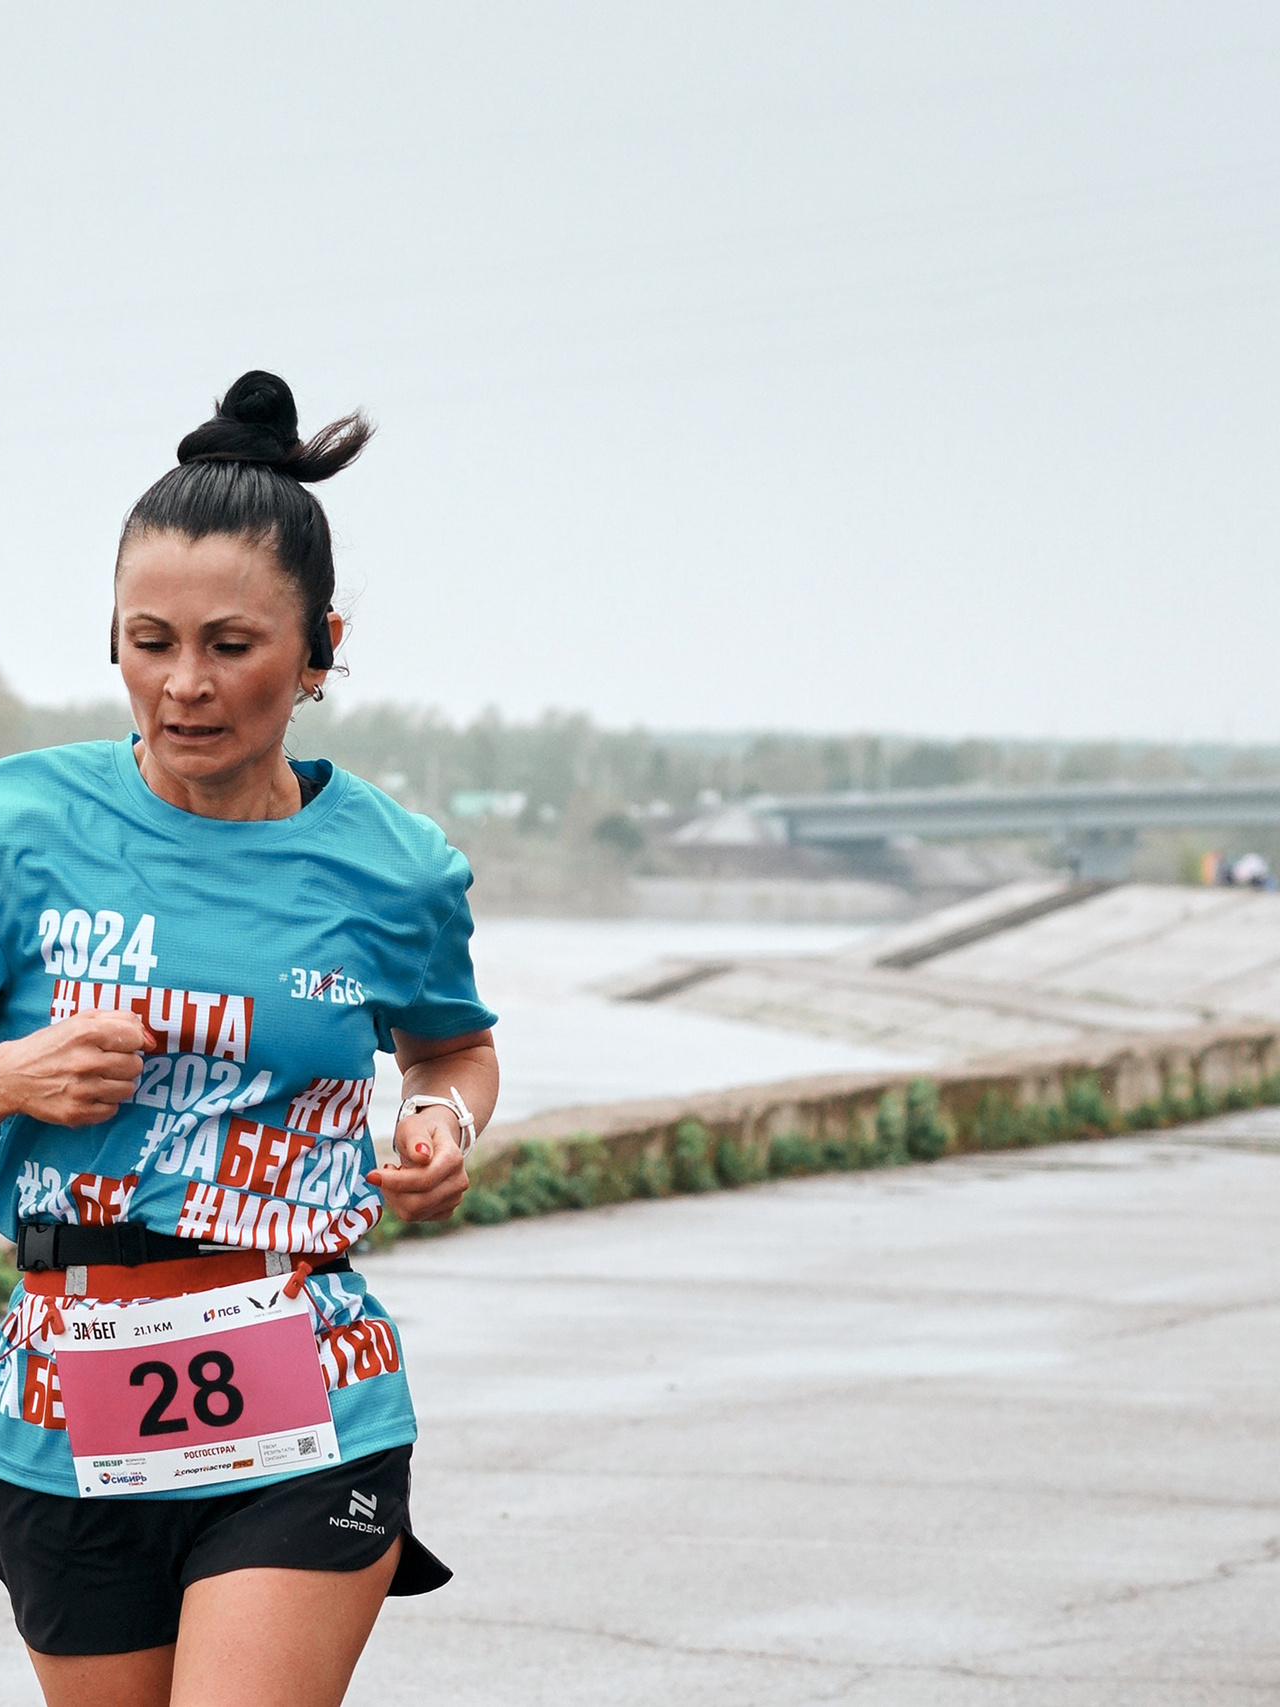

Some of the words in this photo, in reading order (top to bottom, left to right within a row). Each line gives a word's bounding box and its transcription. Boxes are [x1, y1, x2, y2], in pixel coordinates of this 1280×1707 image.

[38, 908, 158, 982] 2024
[217, 1305, 241, 1318] ПСБ
[134, 1325, 151, 1337] 21.1
[129, 1350, 244, 1437] 28
[184, 1444, 237, 1460] РОСГОССТРАХ
[93, 1459, 124, 1468] СИБУР
[233, 1459, 253, 1470] PRO
[111, 1475, 147, 1484] СИБИРЬ
[329, 1516, 386, 1535] NORDSKI
